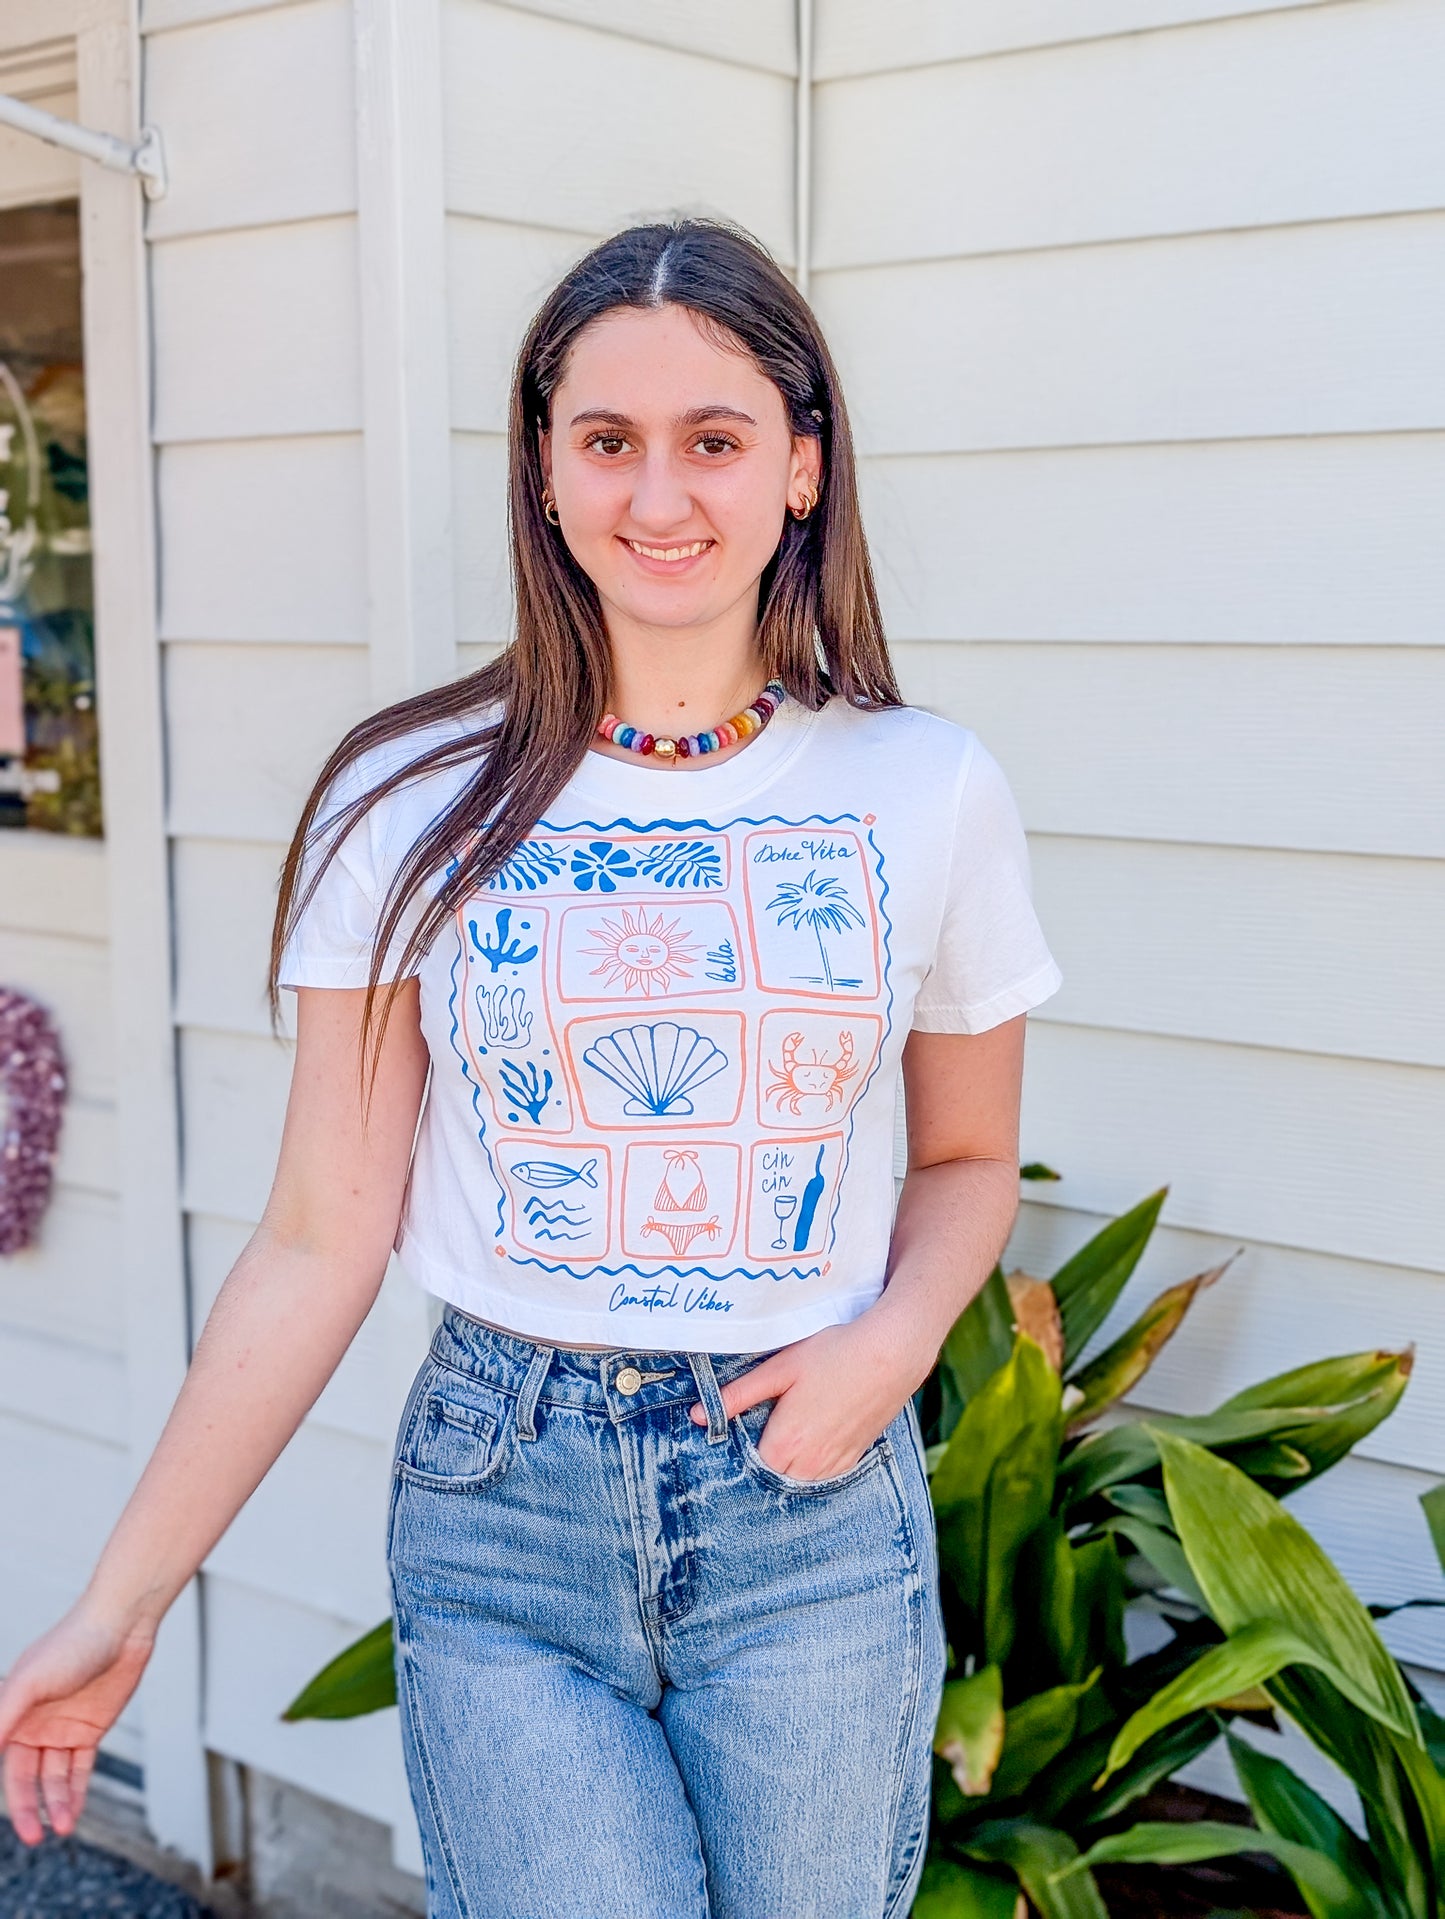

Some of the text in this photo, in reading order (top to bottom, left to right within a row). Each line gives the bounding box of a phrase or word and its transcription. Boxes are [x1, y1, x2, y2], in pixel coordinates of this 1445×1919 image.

[754, 839, 857, 863] Dolce Vita
[705, 938, 736, 982] bella
[763, 1147, 794, 1170] cin
[762, 1171, 792, 1193] cin
[609, 1282, 734, 1313] Coastal Vibes
